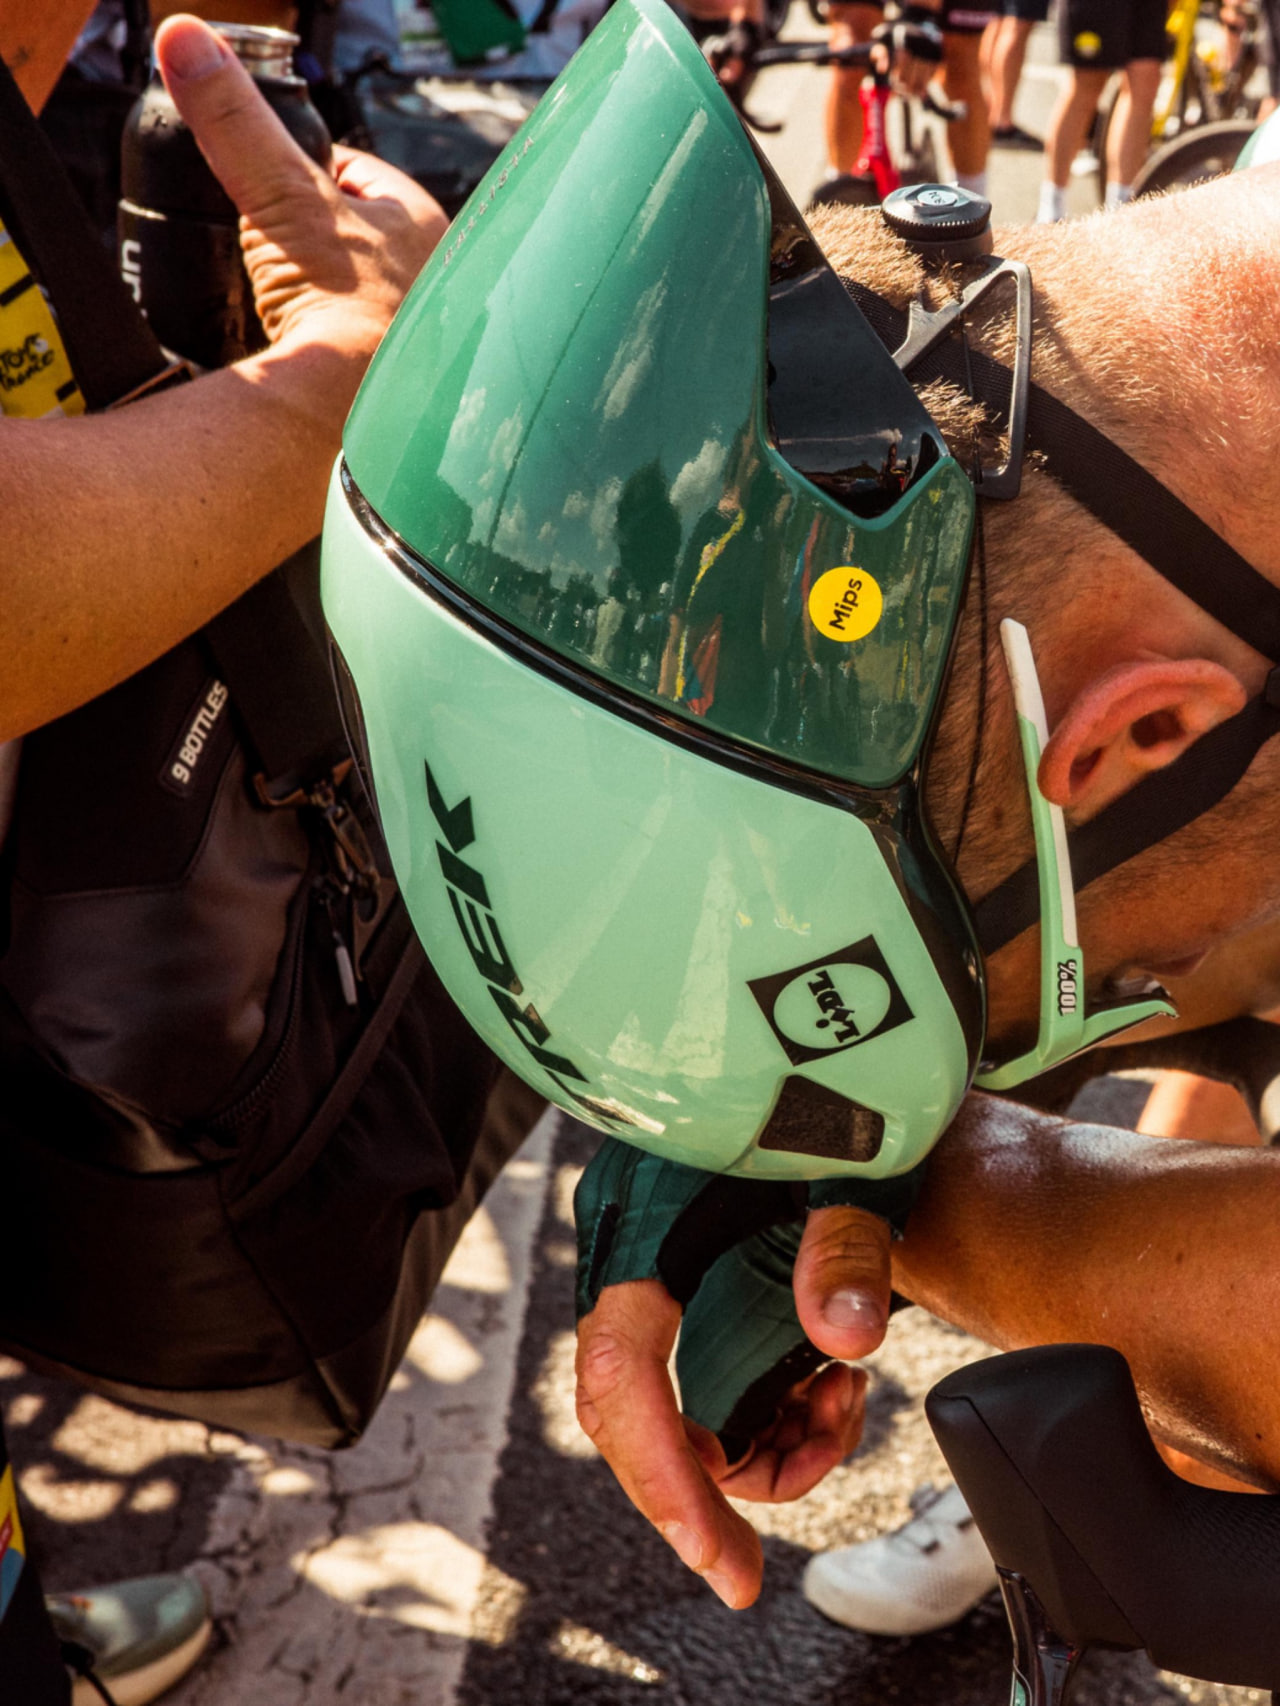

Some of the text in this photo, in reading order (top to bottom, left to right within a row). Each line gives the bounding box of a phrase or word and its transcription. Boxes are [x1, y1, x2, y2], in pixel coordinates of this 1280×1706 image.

[828, 578, 863, 631] Mips
[171, 680, 229, 784] 9 BOTTLES
[1057, 959, 1077, 1016] 100%
